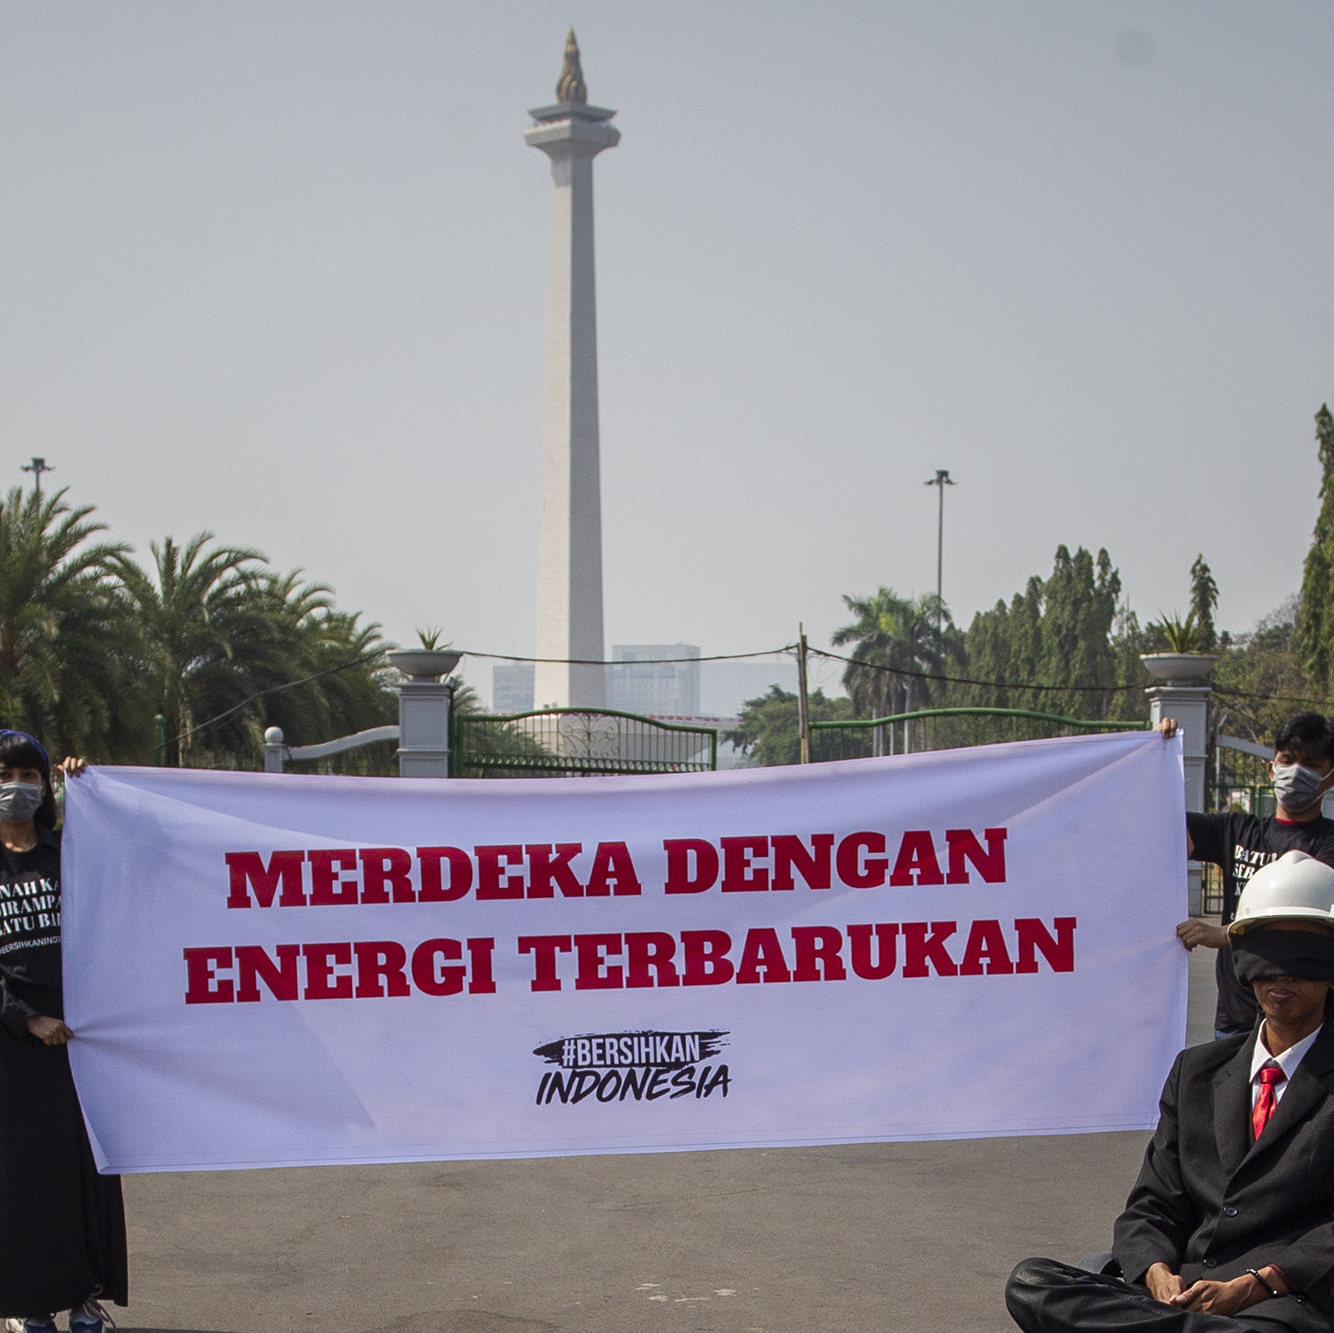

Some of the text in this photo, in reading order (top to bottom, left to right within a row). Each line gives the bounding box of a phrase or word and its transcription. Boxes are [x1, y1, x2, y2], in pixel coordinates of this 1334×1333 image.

[39, 877, 60, 892] KA
[226, 828, 1006, 908] MERDEKA DENGAN
[185, 918, 1076, 1003] ENERGI TERBARUKAN
[561, 1034, 701, 1067] #BERSIHKAN
[536, 1064, 733, 1105] INDONESIA
